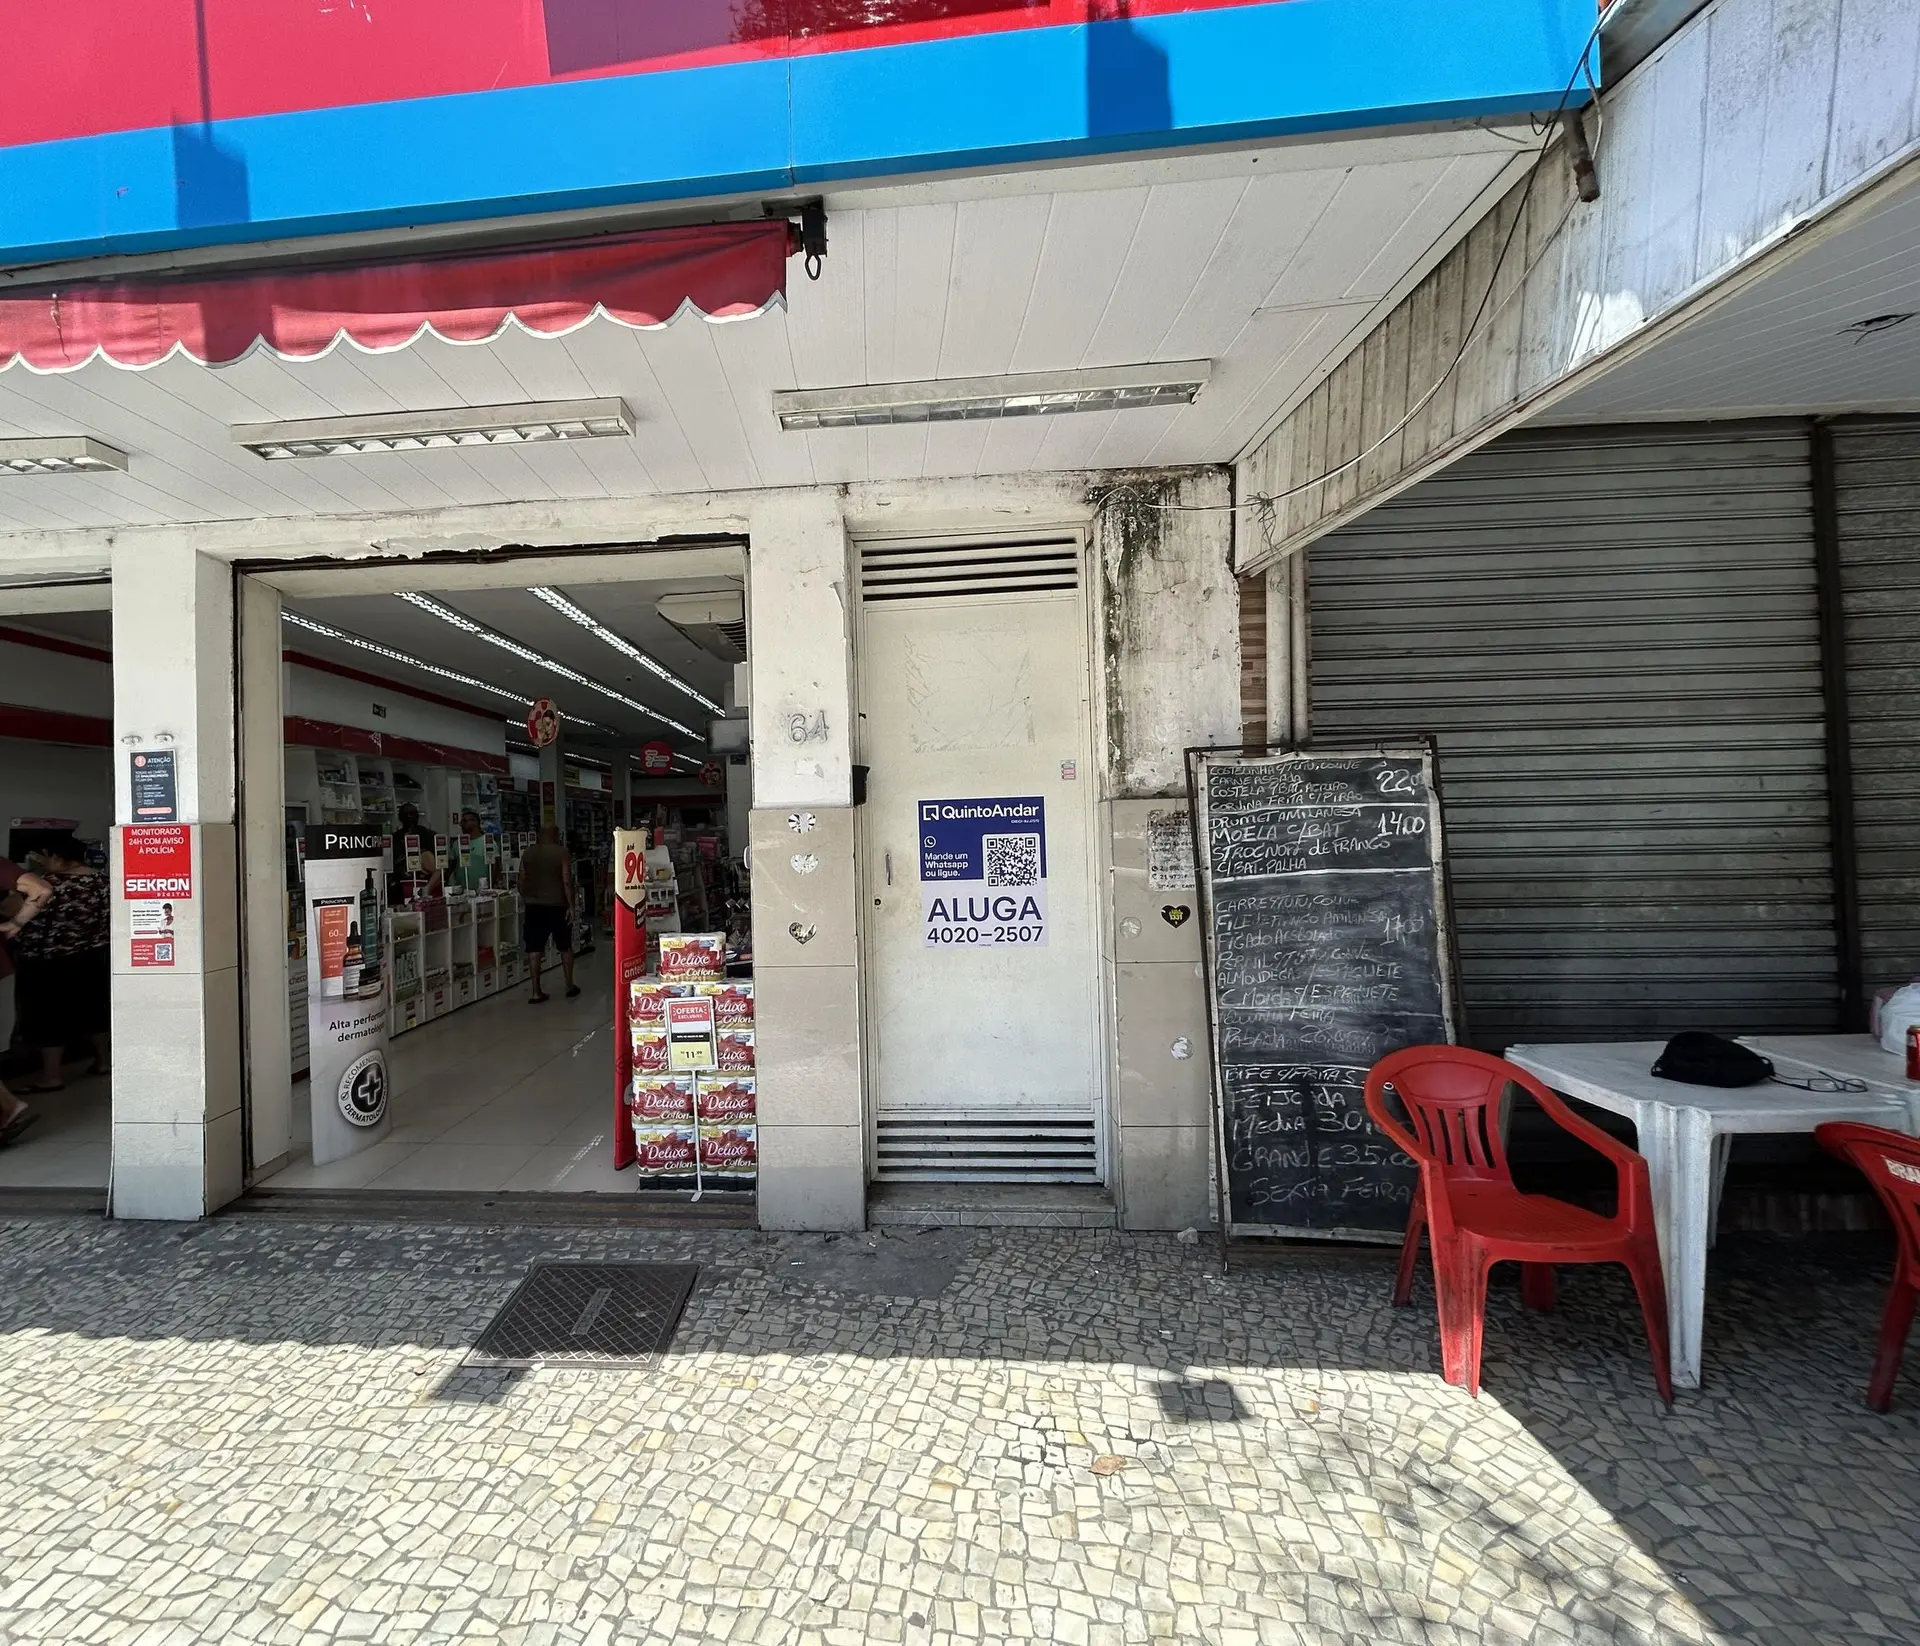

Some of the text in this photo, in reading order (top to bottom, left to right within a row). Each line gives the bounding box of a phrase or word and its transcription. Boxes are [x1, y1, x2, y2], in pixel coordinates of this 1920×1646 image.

[788, 710, 829, 745] 64
[1209, 777, 1251, 786] CARNE
[1210, 785, 1265, 798] COSTELA
[1267, 795, 1304, 806] FRITA
[941, 804, 1039, 819] QuintoAndar
[131, 827, 182, 836] MONITORADO
[1211, 825, 1277, 846] MOELA
[128, 836, 184, 846] 24H COM AVISO
[145, 845, 175, 854] POLÍCIA
[924, 852, 968, 861] Mande um
[924, 860, 969, 871] Whatsapp
[937, 867, 961, 879] ligue.
[126, 878, 190, 892] SEKRON
[927, 896, 1043, 923] ALUGA
[927, 926, 1043, 943] 4020-2507
[668, 951, 711, 966] Deluxe
[640, 997, 665, 1011] Del
[676, 1007, 704, 1015] OFERTA
[328, 1019, 351, 1032] Alta
[643, 1046, 669, 1061] Delu
[718, 1048, 747, 1060] eluxe
[644, 1092, 686, 1109] Deluxe
[706, 1094, 749, 1110] Deluxe
[647, 1145, 690, 1160] Deluxe
[706, 1140, 748, 1156] Deluxe
